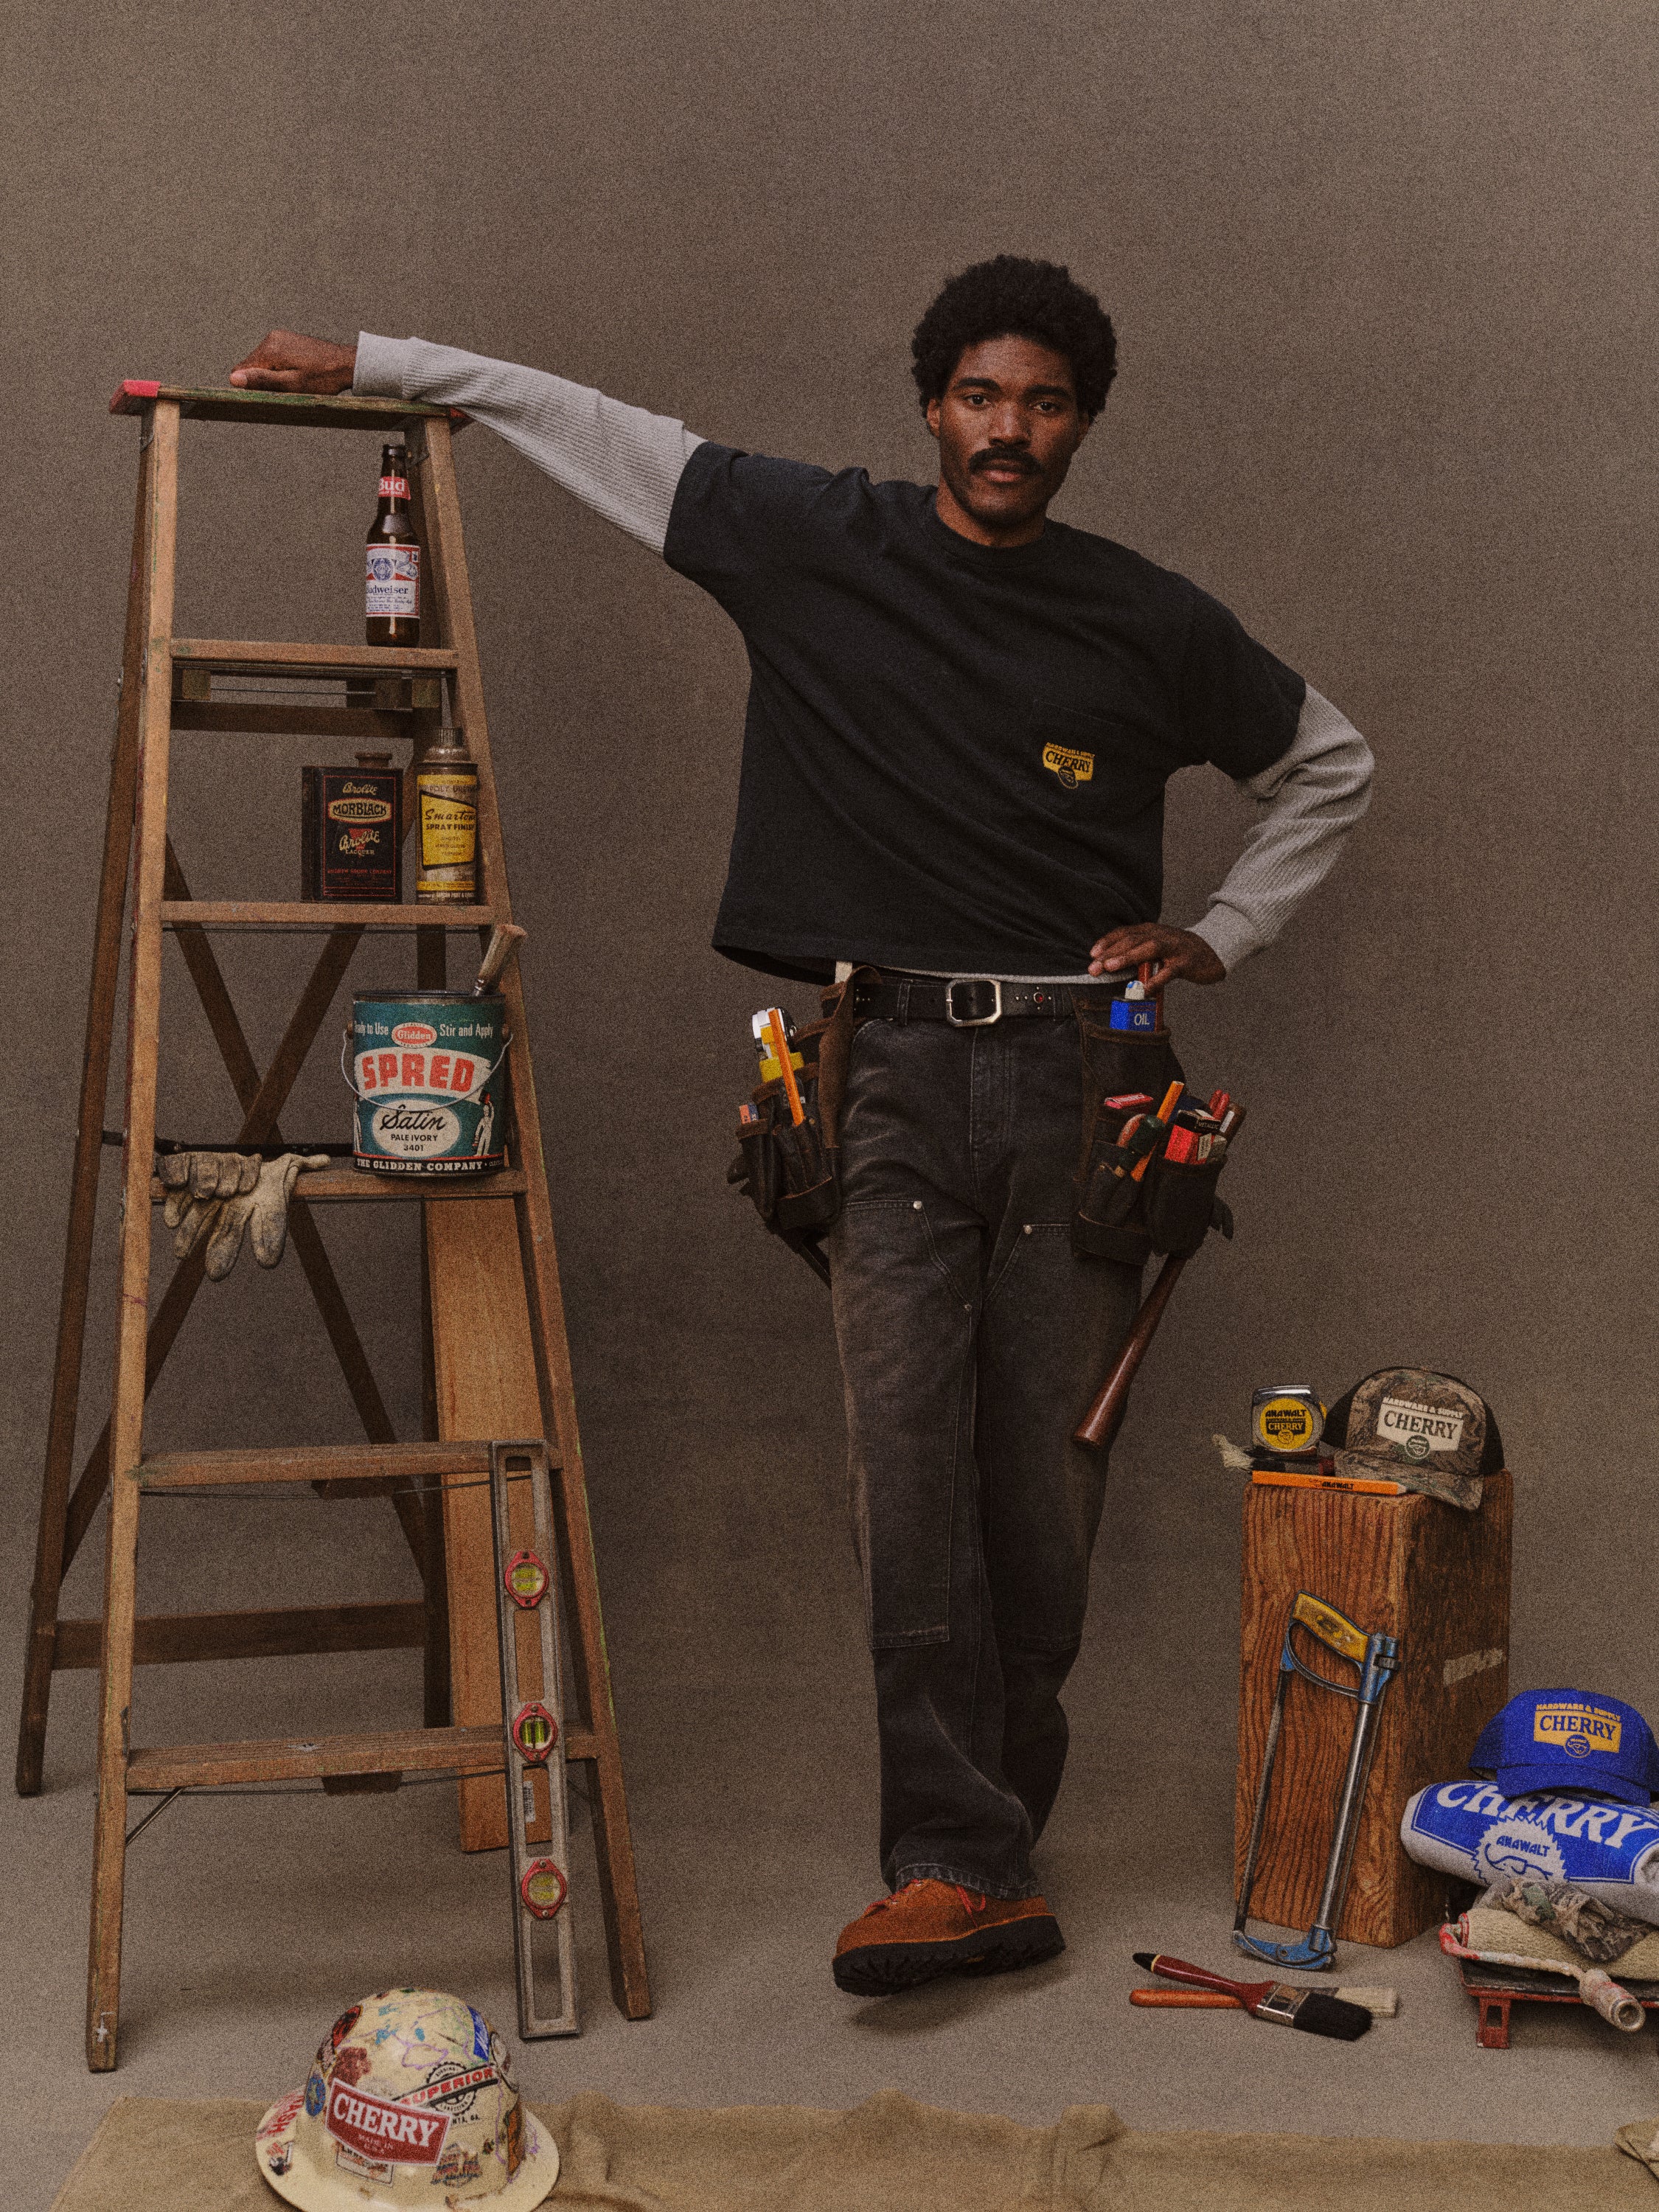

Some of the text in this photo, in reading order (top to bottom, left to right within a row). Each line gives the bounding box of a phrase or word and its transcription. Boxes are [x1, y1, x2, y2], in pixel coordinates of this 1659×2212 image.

[1046, 750, 1091, 773] CHERRY
[342, 782, 378, 796] Brolite
[333, 802, 387, 817] MORBLACK
[338, 830, 380, 852] Brolite
[1134, 1013, 1150, 1026] OIL
[375, 1022, 389, 1035] Use
[397, 1029, 431, 1040] Glidden
[439, 1023, 494, 1039] Stir and Apply
[361, 1053, 476, 1093] SPRED
[380, 1103, 447, 1130] Satin
[357, 1158, 370, 1168] THE
[373, 1161, 422, 1172] GLIDDEN
[426, 1161, 483, 1172] COMPANY
[1382, 1396, 1428, 1412] HARDWARE
[1265, 1409, 1307, 1418] ANAWALT
[1268, 1422, 1303, 1430] CHERRY
[1383, 1410, 1458, 1439] CHERRY
[1536, 1703, 1584, 1711] HARDWARE
[1540, 1715, 1616, 1741] CHERRY
[1496, 1834, 1551, 1857] ANAWALT
[333, 2093, 440, 2148] CHERRY
